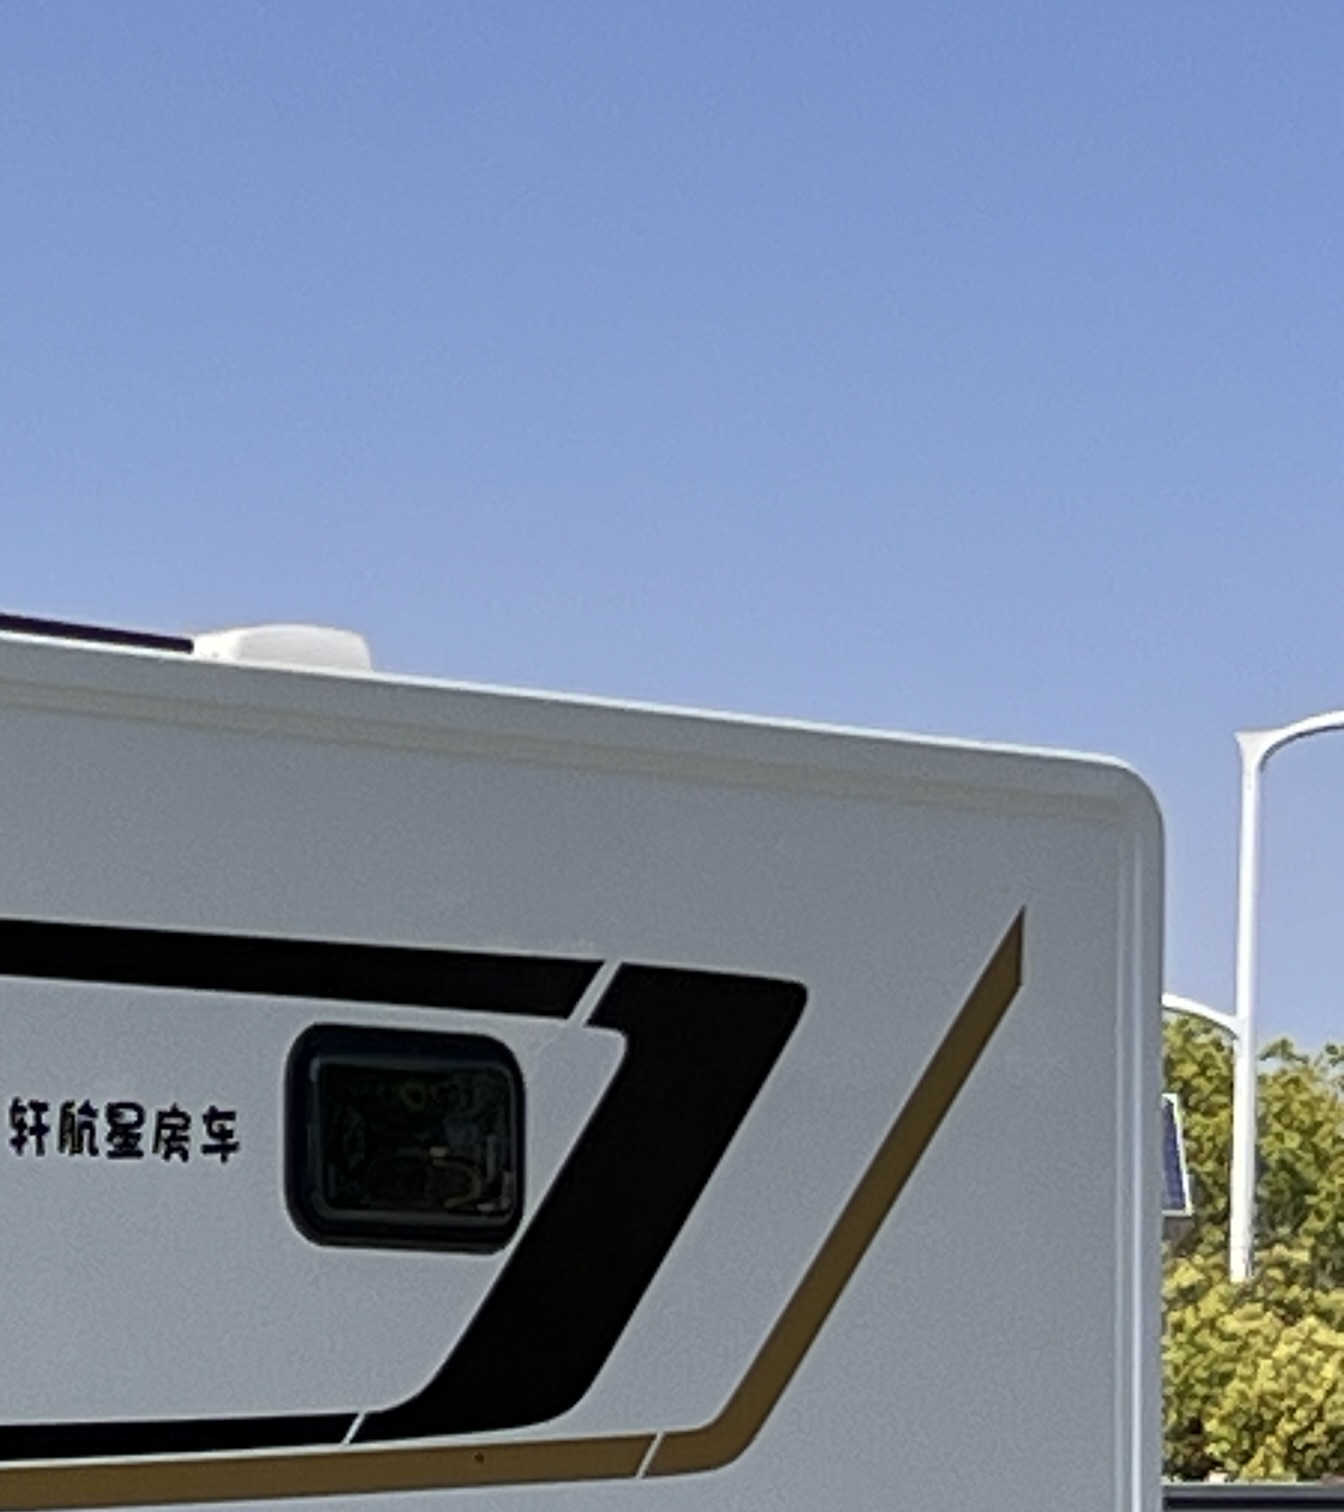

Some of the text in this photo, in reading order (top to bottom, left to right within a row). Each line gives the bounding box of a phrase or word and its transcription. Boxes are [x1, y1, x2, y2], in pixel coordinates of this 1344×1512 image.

[9, 1097, 240, 1163] 轩航星房车
